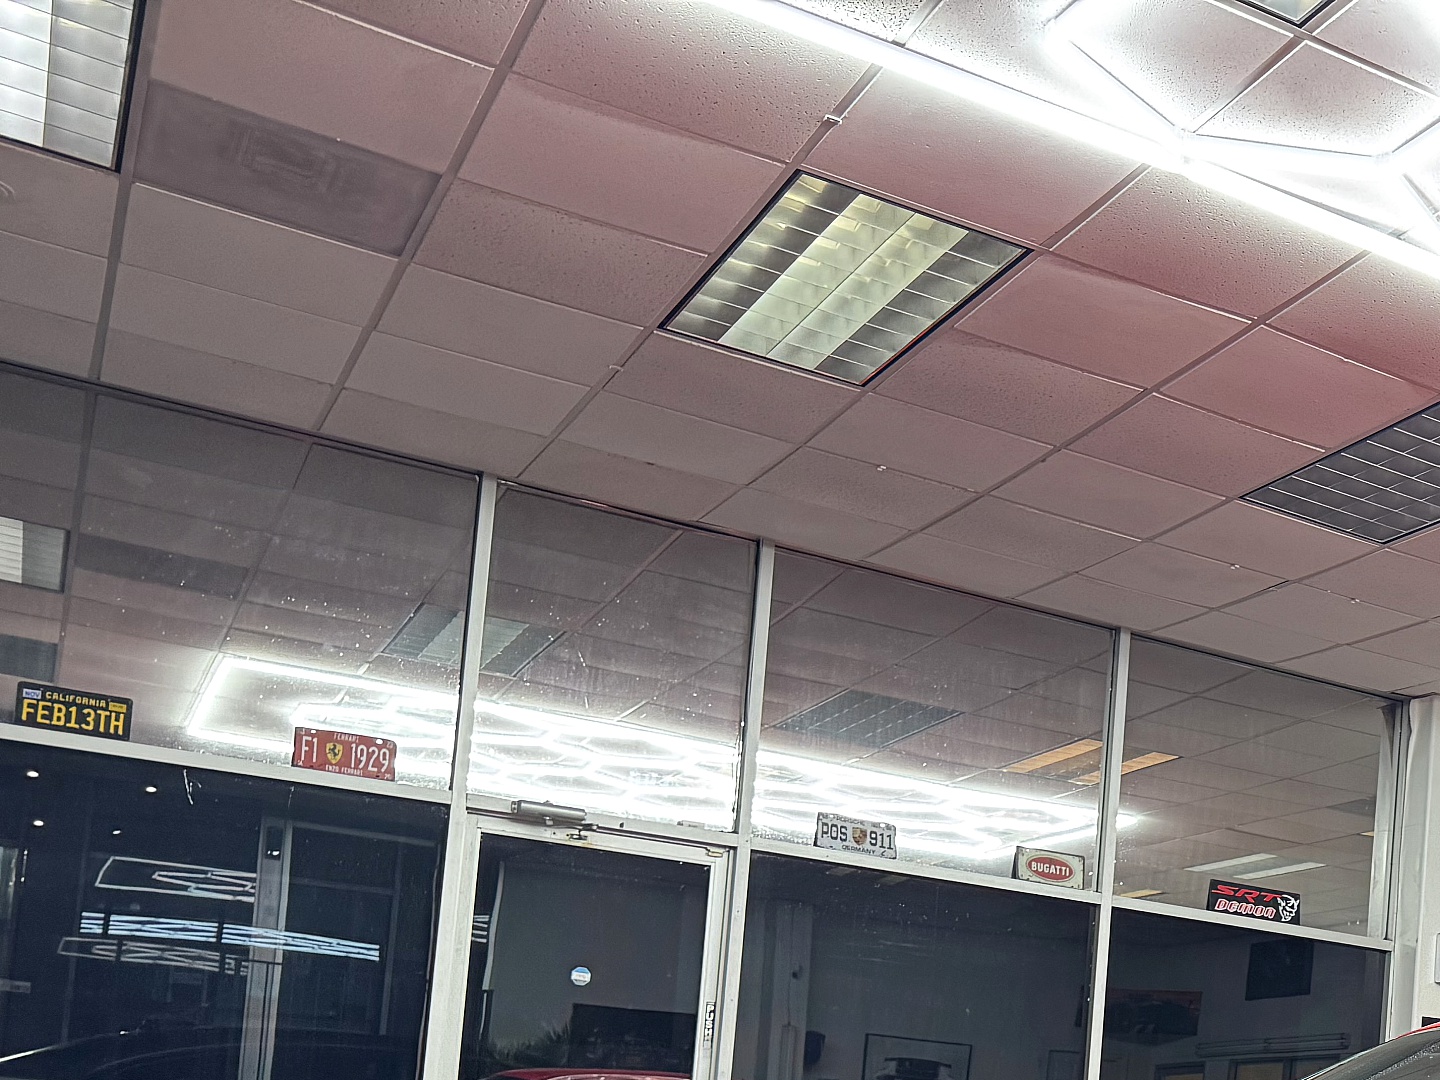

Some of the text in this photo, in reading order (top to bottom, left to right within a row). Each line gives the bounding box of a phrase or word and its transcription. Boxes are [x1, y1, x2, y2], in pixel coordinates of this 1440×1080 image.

[45, 691, 106, 708] CALIFORNIA
[21, 699, 125, 736] FEB13TH
[301, 735, 390, 773] F1 1929
[821, 821, 894, 850] POS 911
[841, 844, 877, 855] GERMANY
[1031, 861, 1070, 877] BUGATTI
[1211, 884, 1283, 903] SRT
[704, 1004, 715, 1037] PUSH
